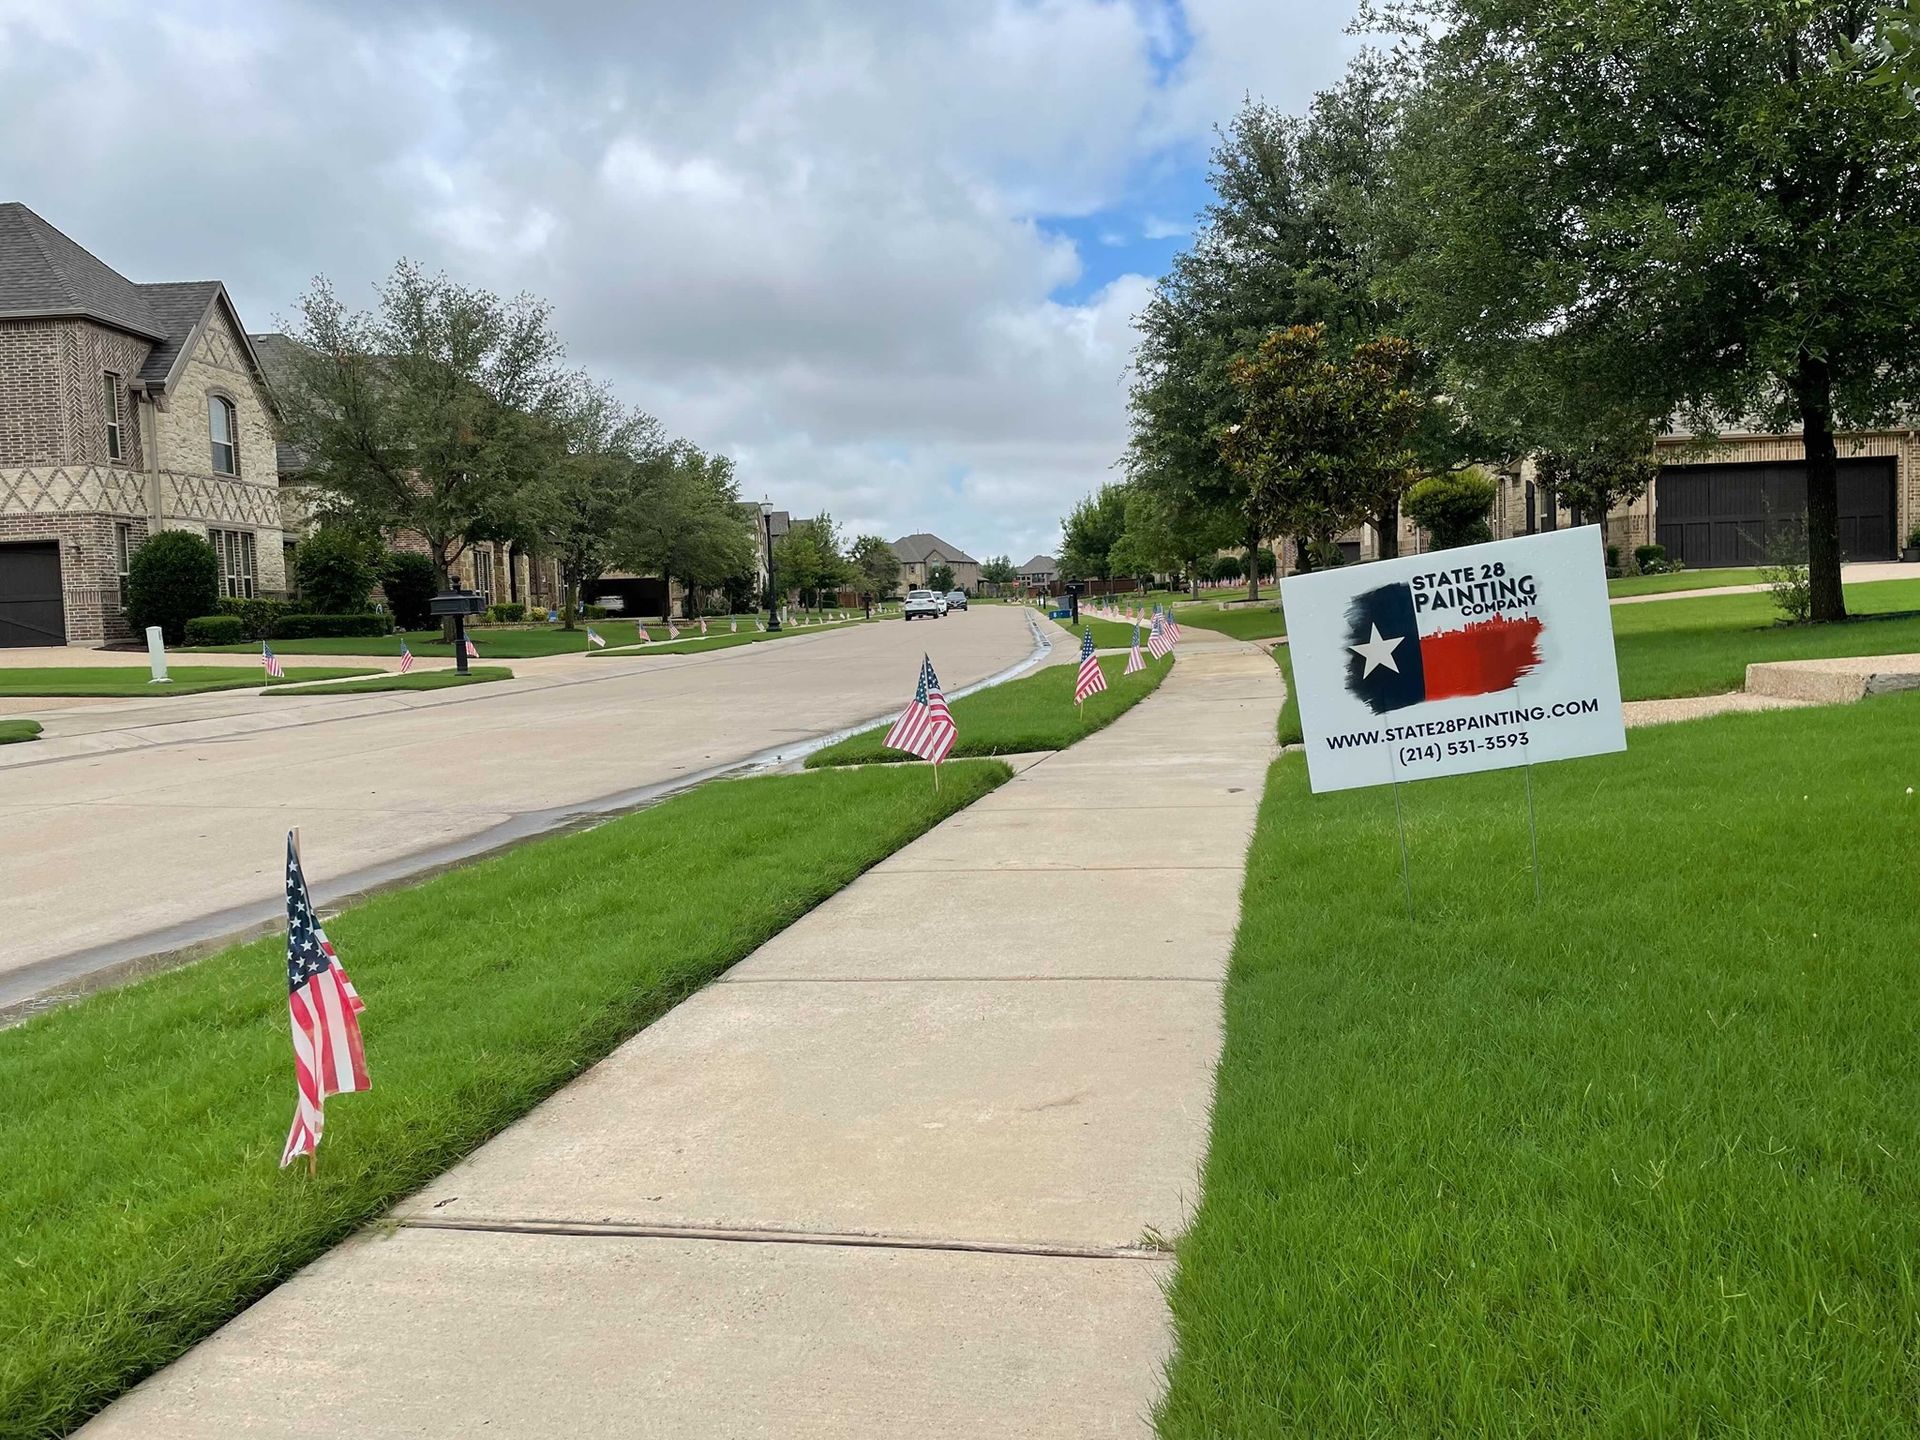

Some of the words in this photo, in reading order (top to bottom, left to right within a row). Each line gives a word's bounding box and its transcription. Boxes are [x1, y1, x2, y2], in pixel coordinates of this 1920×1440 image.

[1412, 566, 1474, 591] STATE
[1480, 562, 1506, 580] 28
[1414, 575, 1536, 613] PAINTING
[1461, 594, 1538, 617] COMPANY
[1326, 698, 1599, 750] WWW.STATE28PAINTING.COM
[1399, 742, 1442, 766] (214)
[1447, 732, 1530, 756] 531-3593
